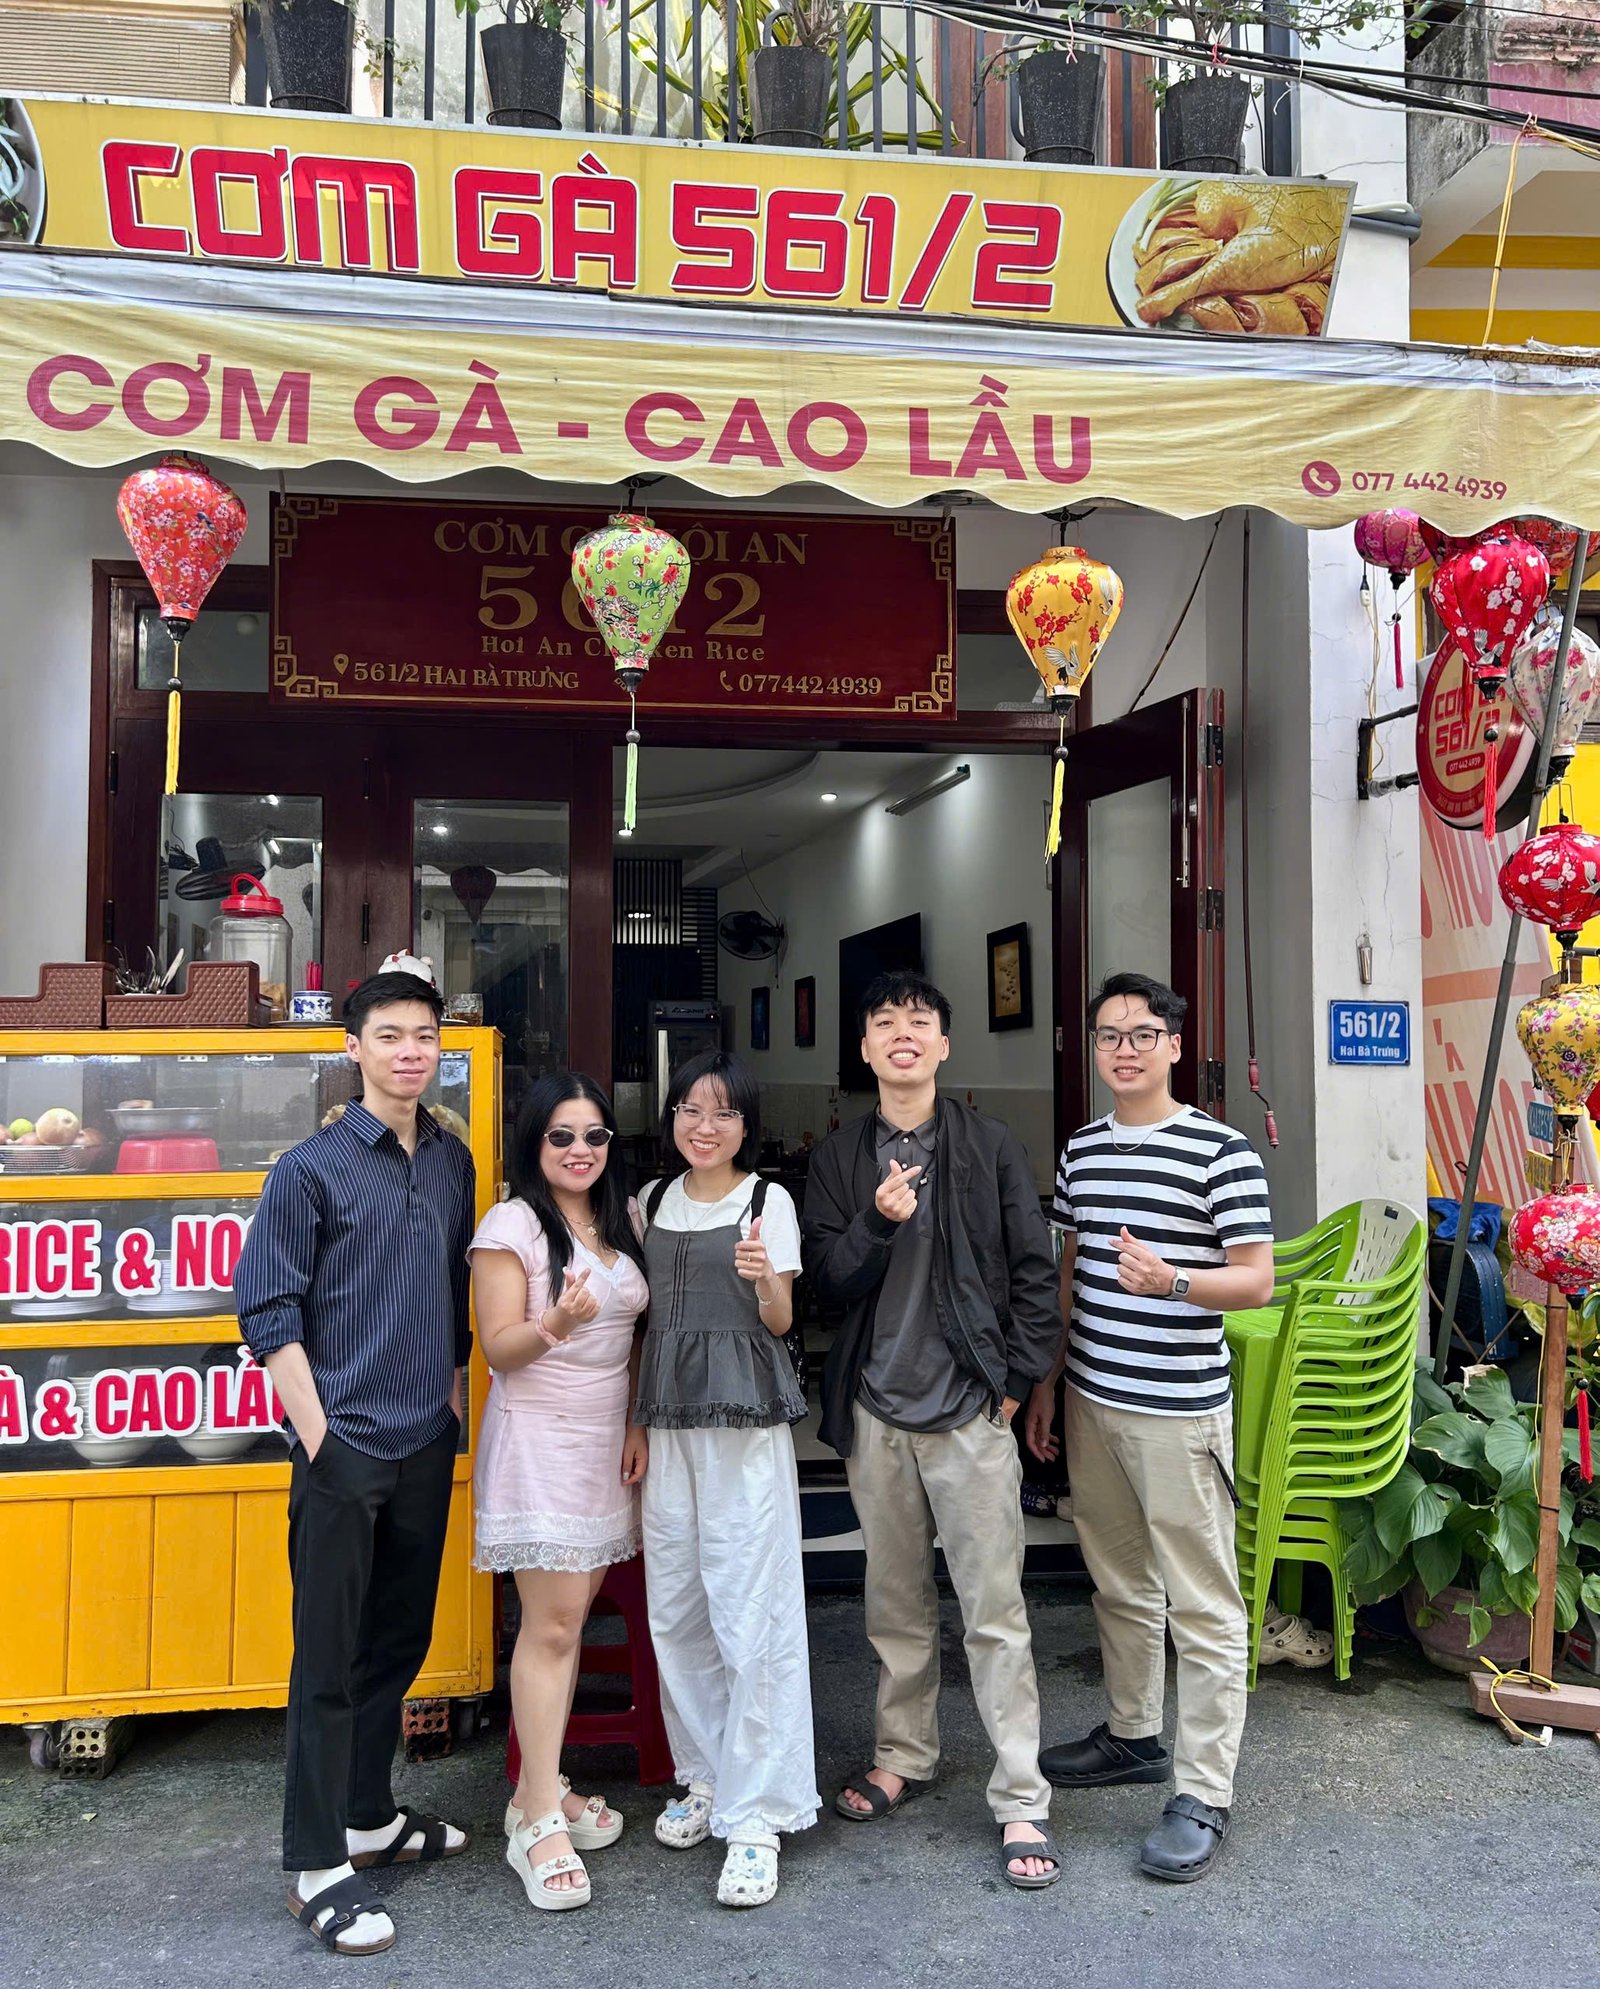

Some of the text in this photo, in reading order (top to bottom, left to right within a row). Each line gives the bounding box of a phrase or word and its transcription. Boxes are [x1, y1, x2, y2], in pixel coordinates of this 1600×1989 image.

[103, 139, 1063, 311] CƠM GÀ 561/2
[26, 352, 311, 445] CƠM
[353, 359, 523, 455] GÀ
[624, 391, 868, 473] CAO
[908, 373, 1092, 485] LẦU
[1352, 471, 1508, 500] 077 442 4939
[434, 517, 550, 556] CƠM
[668, 522, 731, 565] ỘI
[740, 531, 809, 565] AN
[537, 636, 572, 656] An
[584, 638, 694, 660] Cken
[706, 640, 765, 661] Rice
[354, 662, 579, 689] 561/2 HAI BÀ TRƯNG
[739, 674, 882, 695] 0774424939
[1340, 1011, 1401, 1038] 561/2
[1340, 1045, 1400, 1058] Hai Bà Trưng
[119, 1232, 155, 1290] &
[40, 1386, 77, 1436] &
[95, 1372, 196, 1434] CAO
[213, 1350, 286, 1428] LẦ
